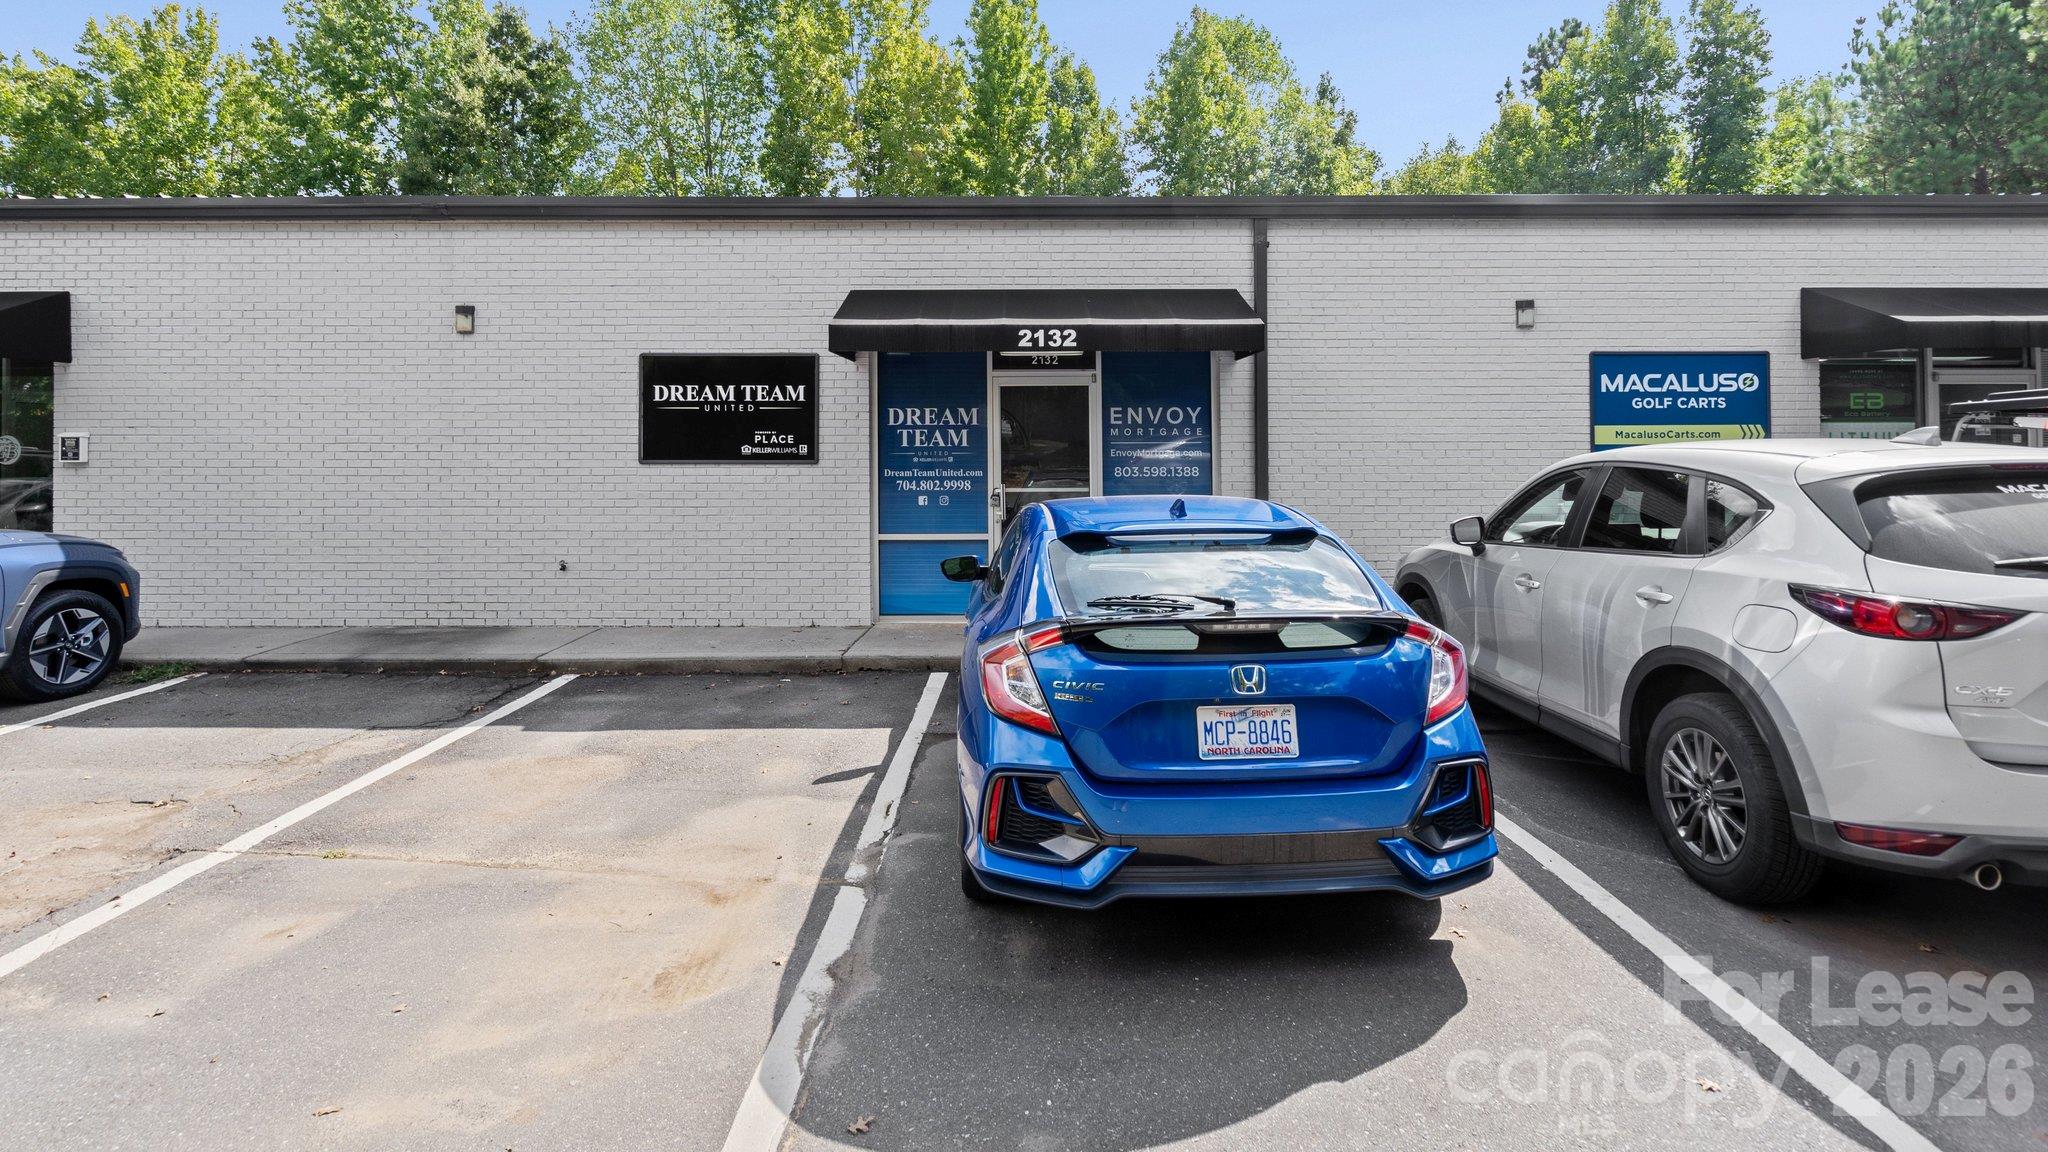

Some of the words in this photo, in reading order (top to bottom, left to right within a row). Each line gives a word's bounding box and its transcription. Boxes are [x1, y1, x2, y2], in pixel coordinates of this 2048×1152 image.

[1018, 329, 1077, 347] 2132
[1032, 355, 1059, 365] 2132
[1600, 373, 1760, 393] MACALUSO
[653, 385, 736, 402] DREAM
[741, 385, 806, 402] TEAM
[704, 404, 755, 412] UNITED
[1632, 397, 1673, 409] GOLF
[1677, 397, 1727, 409] CARTS
[887, 407, 979, 426] DREAM
[1110, 407, 1202, 424] ENVOY
[1110, 428, 1203, 436] MORTGAGE
[1615, 430, 1721, 440] MacalusoCarts.com
[754, 435, 794, 444] PLACE
[897, 429, 969, 447] TEAM
[1110, 449, 1203, 459] EnvoyMortgage.com
[884, 468, 983, 477] DreamTeamUnited.com
[1114, 466, 1200, 477] 803.598.1388
[896, 480, 971, 491] 704.802.9998
[1053, 680, 1105, 691] CIVIC
[1955, 685, 2015, 696] CX-5
[1203, 720, 1292, 746] MCP-8846
[1207, 747, 1240, 756] NORTH
[1244, 745, 1291, 755] CAROLINA
